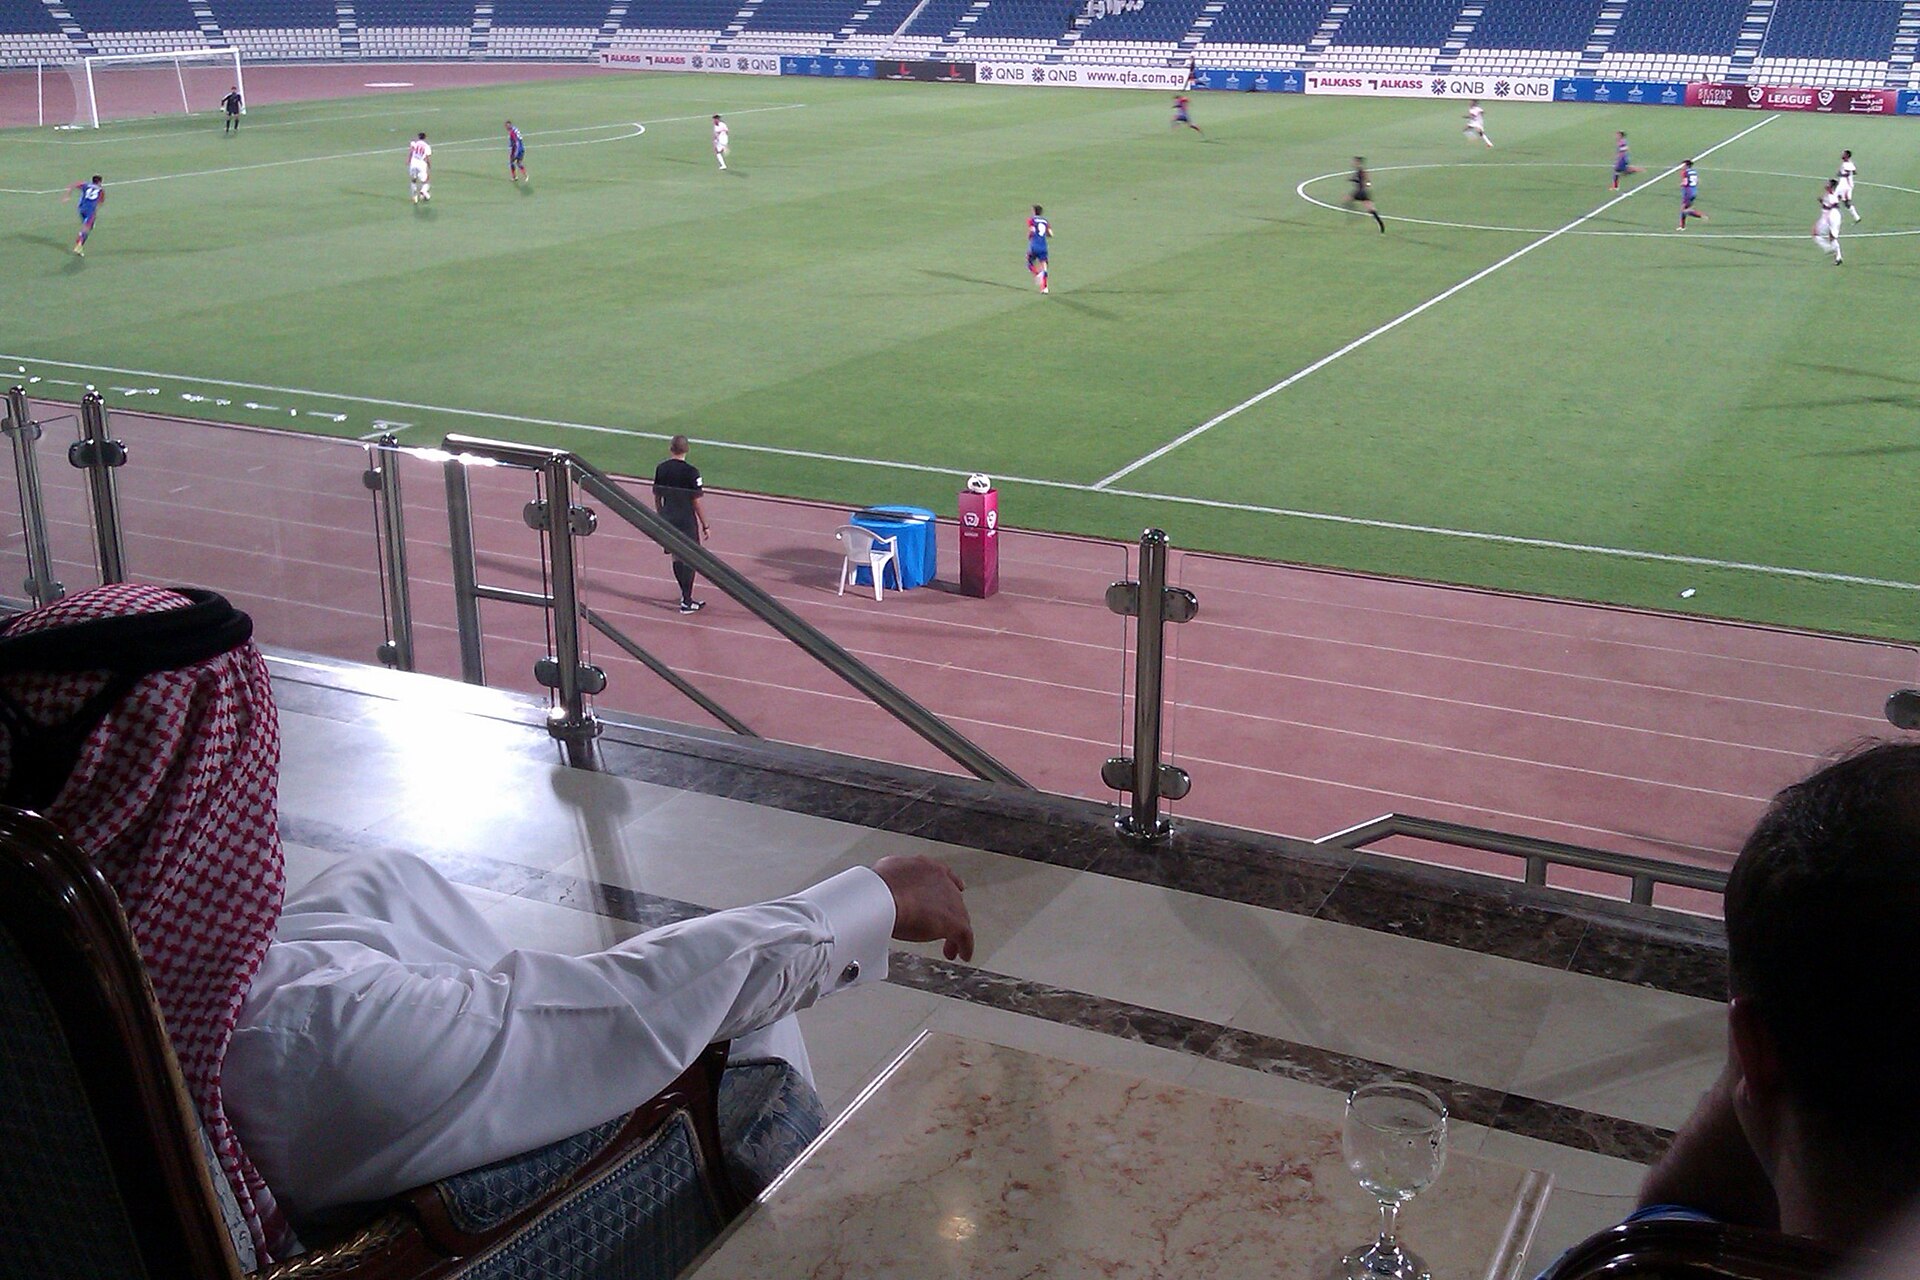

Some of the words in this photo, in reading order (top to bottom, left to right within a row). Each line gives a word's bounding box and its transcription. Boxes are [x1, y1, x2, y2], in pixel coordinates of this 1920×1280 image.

[610, 54, 640, 63] ALKASS
[654, 56, 686, 64] ALKASS
[706, 57, 731, 69] QNB
[751, 59, 777, 71] QNB
[995, 68, 1025, 80] QNB
[1048, 69, 1077, 82] QNB
[1087, 70, 1184, 86] www.qfa.com.qa
[1320, 78, 1362, 87] ALKASS
[1380, 79, 1423, 89] ALKASS
[1450, 81, 1485, 94] QNB
[1513, 82, 1549, 96] QNB
[1768, 94, 1812, 105] LEAGUE
